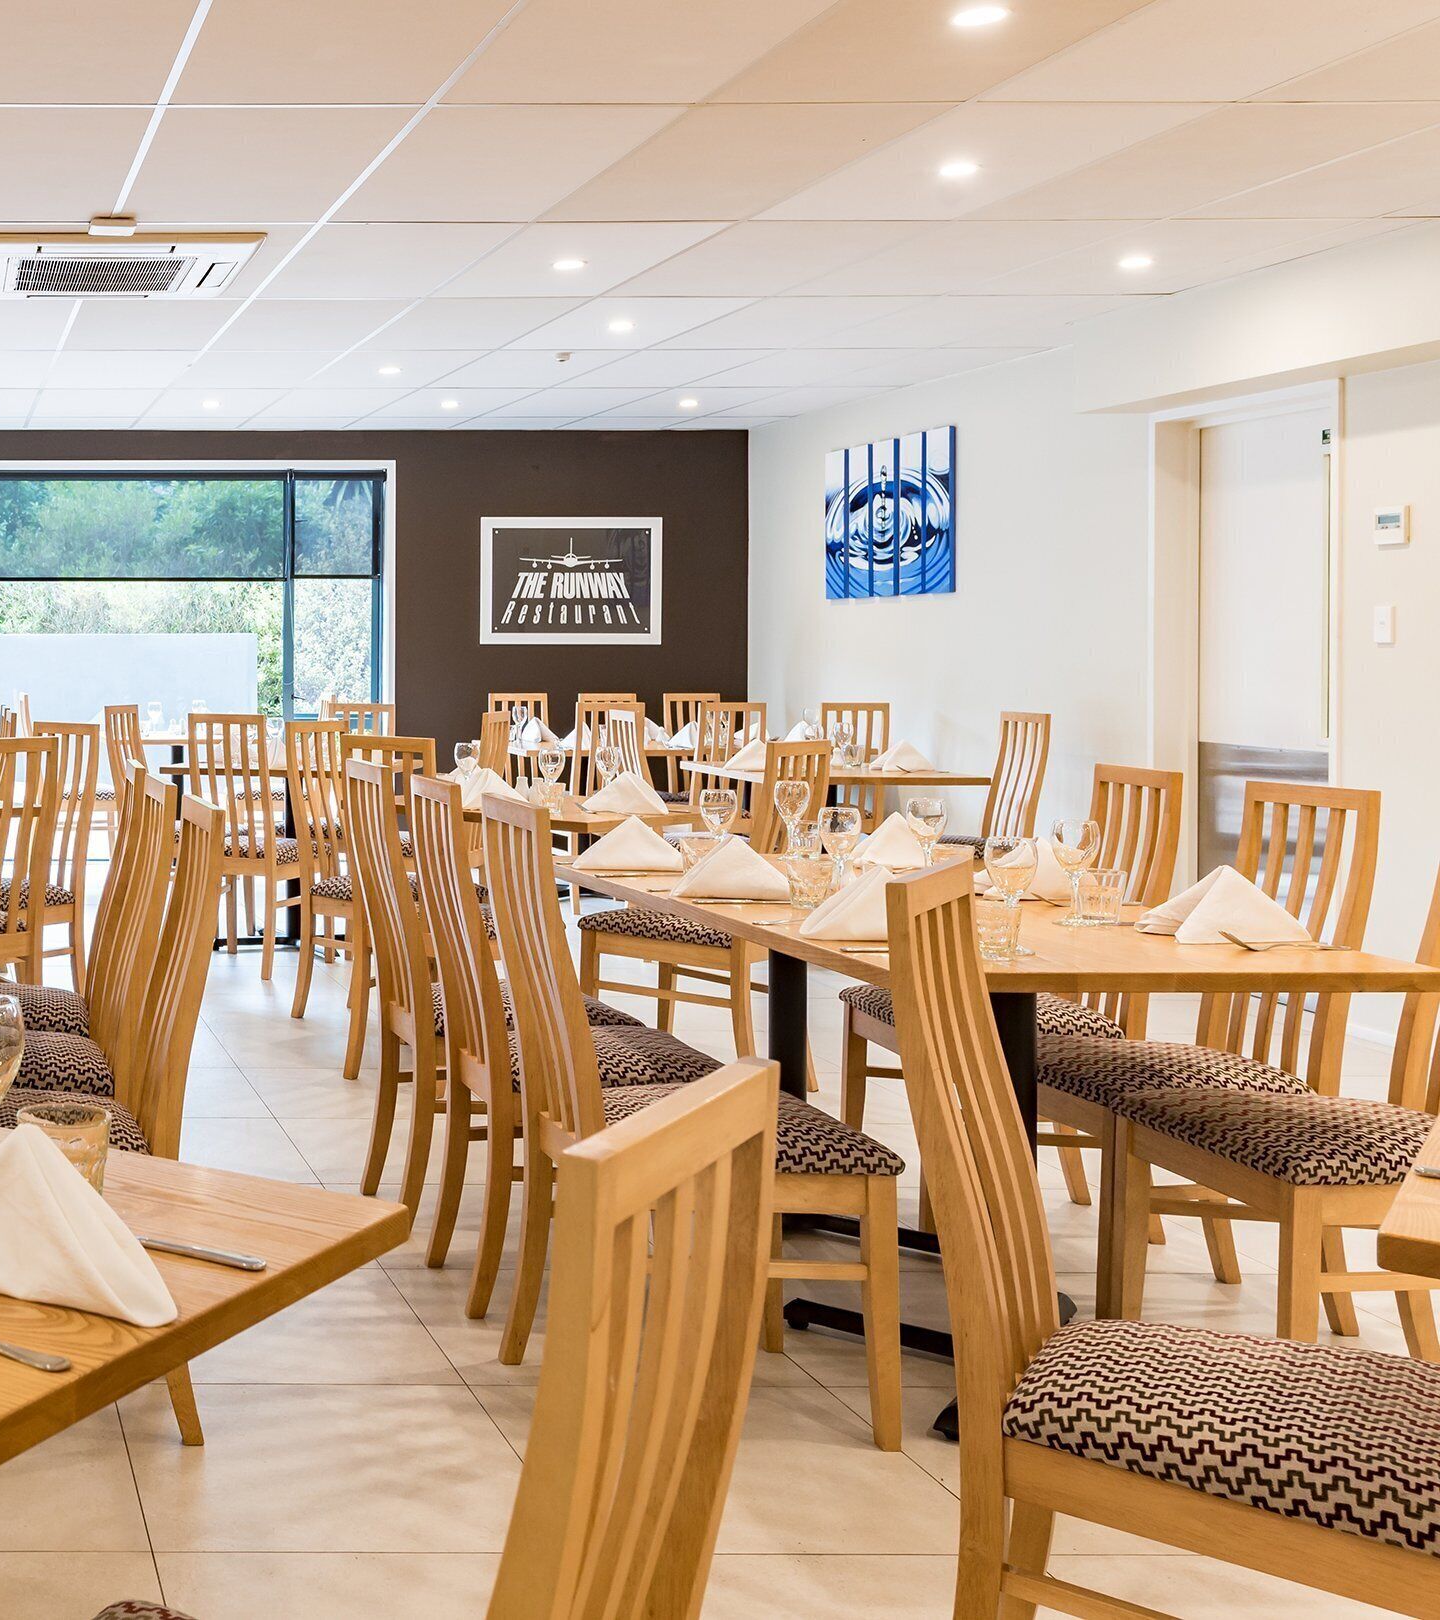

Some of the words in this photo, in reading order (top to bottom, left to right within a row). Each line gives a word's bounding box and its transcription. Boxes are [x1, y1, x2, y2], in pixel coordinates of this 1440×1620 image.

[511, 572, 548, 599] THE
[550, 572, 631, 600] RUNWAY
[500, 600, 641, 625] Restaurant
